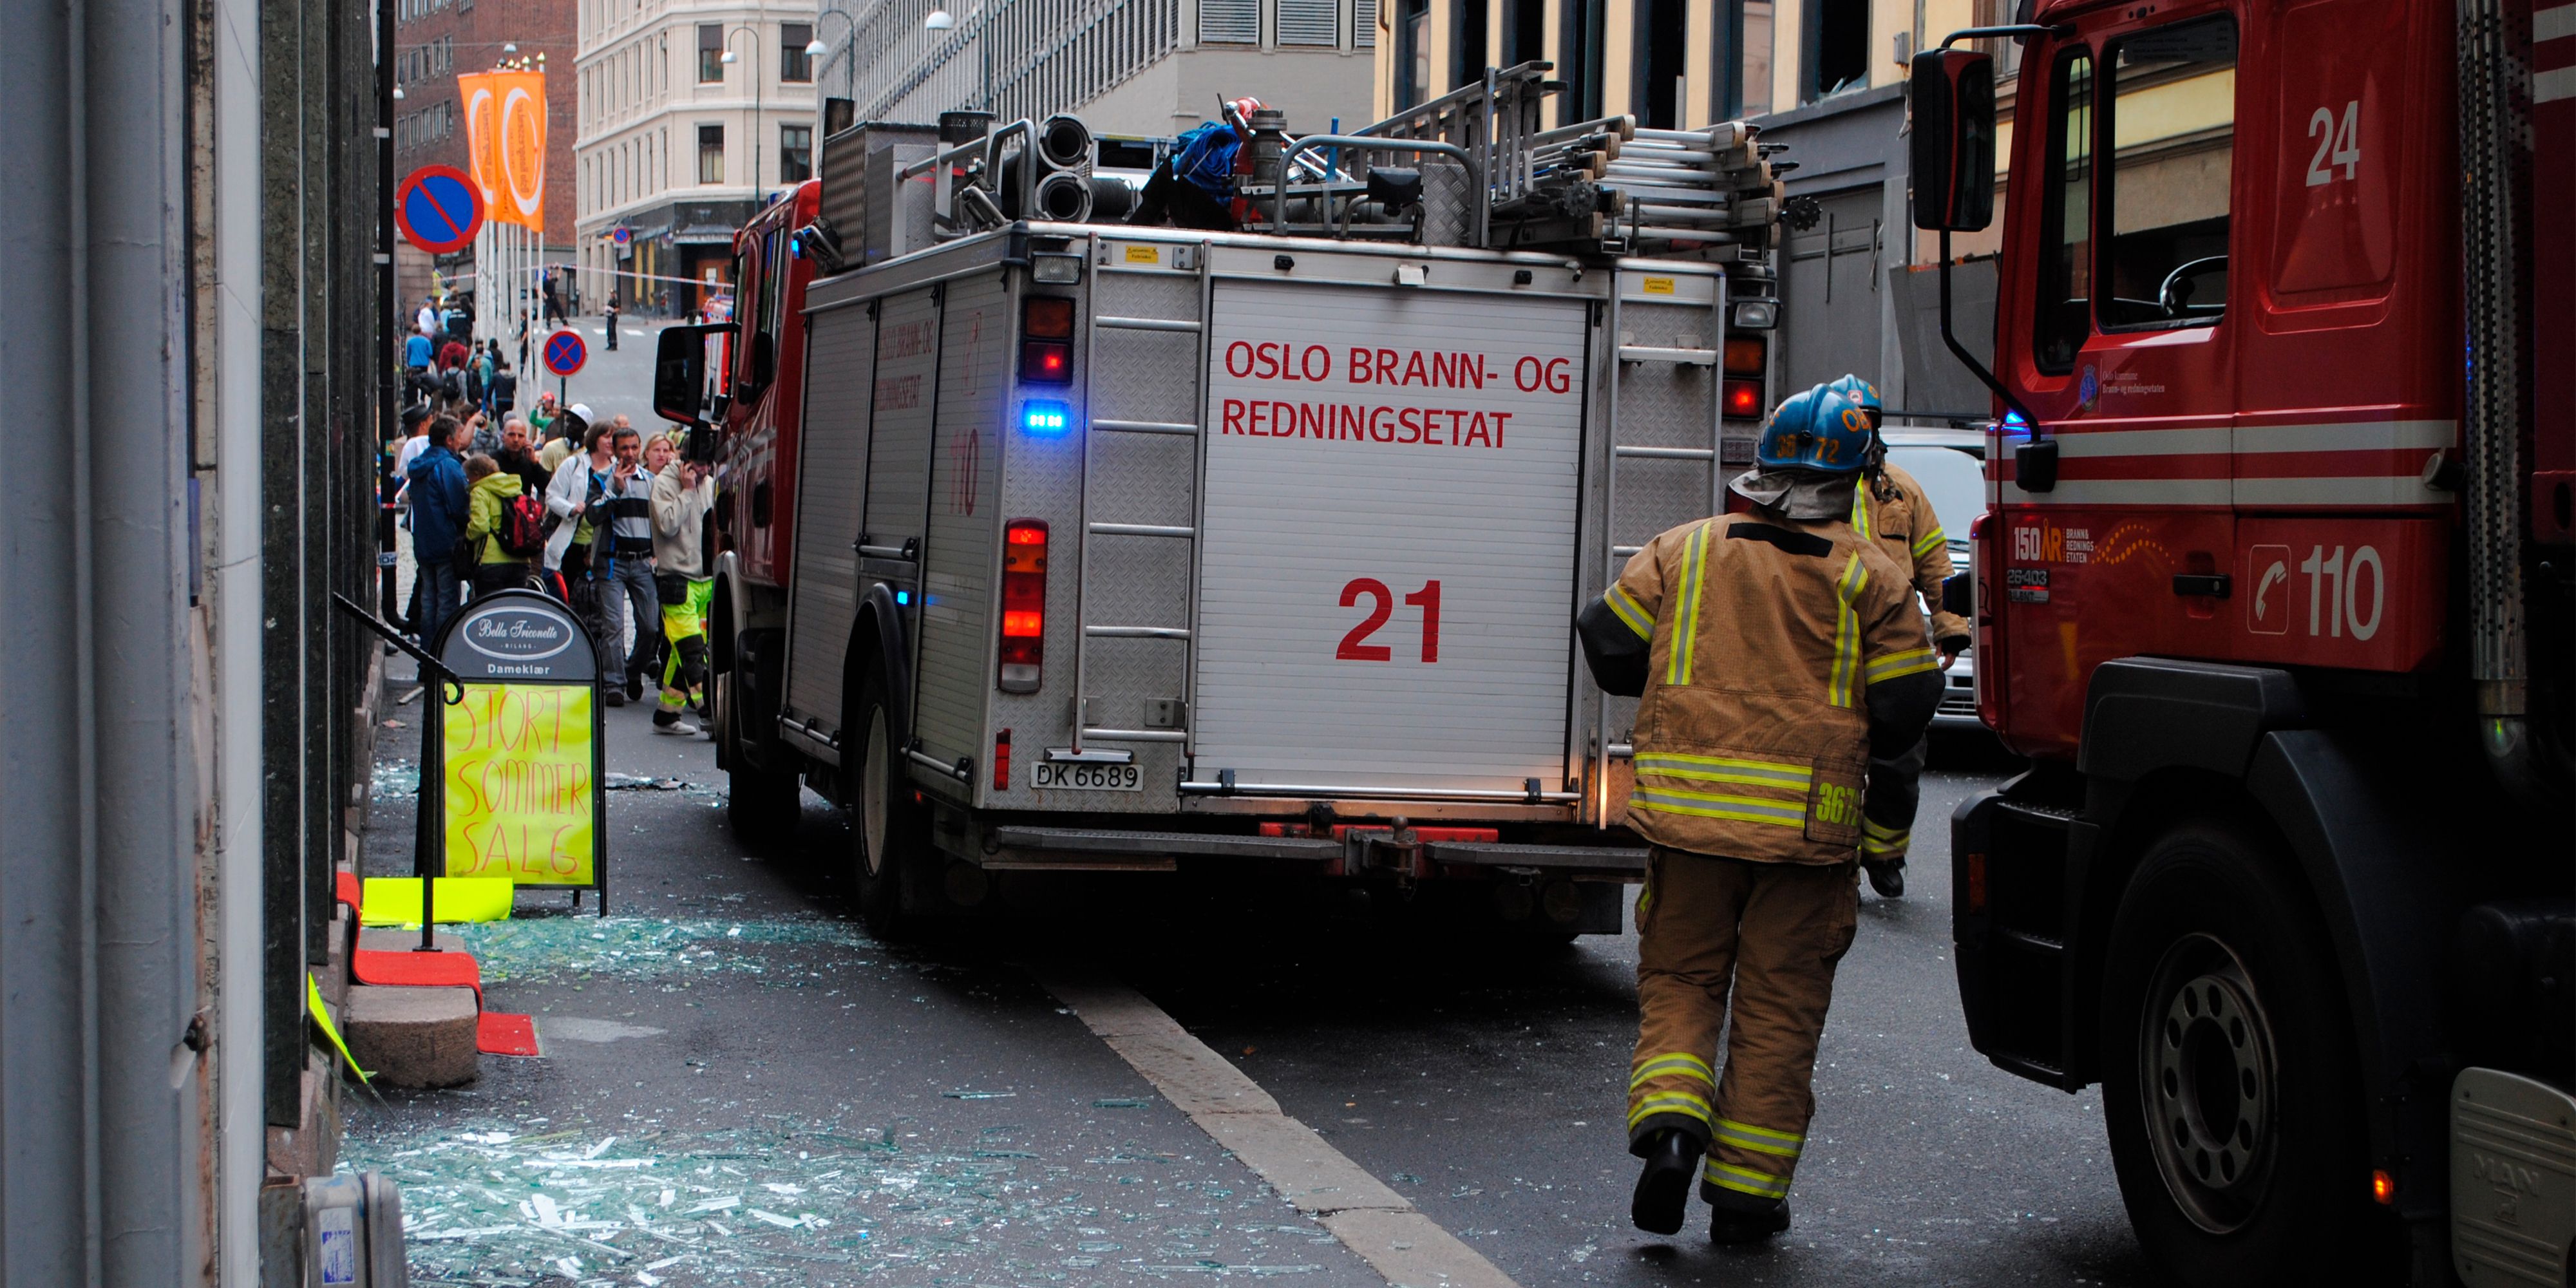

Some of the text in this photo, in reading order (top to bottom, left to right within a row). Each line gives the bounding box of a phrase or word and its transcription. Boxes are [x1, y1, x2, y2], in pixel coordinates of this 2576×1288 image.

[2306, 100, 2360, 187] 24
[923, 319, 934, 354] OG
[1225, 341, 1570, 393] OSLO BRANN- OG
[1222, 399, 1513, 448] REDNINGSETAT
[949, 428, 979, 517] 110
[1816, 437, 1840, 463] 72
[2066, 540, 2094, 551] REDNINGS
[2066, 553, 2087, 563] ETATEN
[2300, 545, 2384, 641] 110
[478, 618, 507, 638] Bella
[1336, 577, 1441, 663] 21
[488, 663, 551, 675] Dameklær
[457, 688, 571, 753] STORT
[457, 758, 588, 817] SOMMER
[1037, 764, 1139, 788] DK 6689
[462, 821, 578, 875] SALG
[2473, 1153, 2539, 1198] MAN
